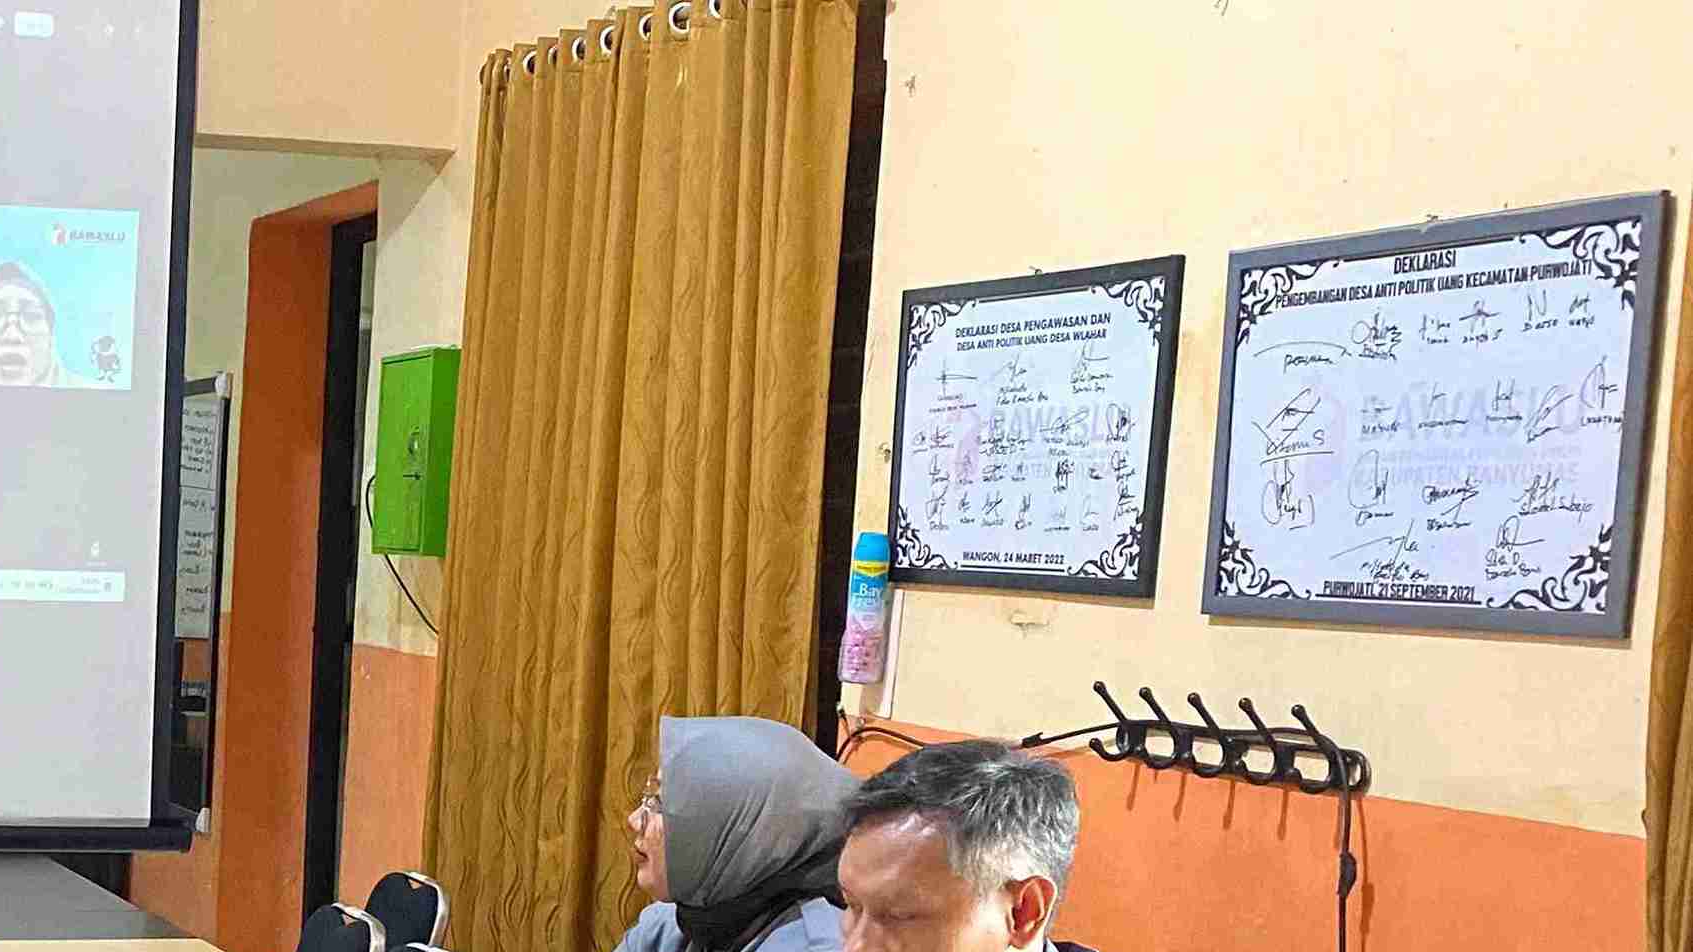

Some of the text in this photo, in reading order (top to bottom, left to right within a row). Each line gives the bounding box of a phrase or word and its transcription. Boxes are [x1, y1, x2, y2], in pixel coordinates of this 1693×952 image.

[1394, 250, 1456, 275] DEKLARASI
[1275, 259, 1592, 309] PENGEMBANGAN DESA ANTI POLITIK UANG KECAMATAN PURWOJATI
[955, 312, 1111, 338] DEKLARASI DESA PENGAWASAN DAN
[957, 341, 975, 351] DESA
[977, 338, 994, 350] ANTI
[996, 336, 1023, 348] POLITIK
[1024, 334, 1048, 345] UANG
[1050, 331, 1070, 343] DESA
[1004, 552, 1014, 562] 24
[1016, 552, 1043, 564] MARET
[1379, 583, 1389, 597] 21
[1390, 583, 1448, 600] SEPTEMBER
[1450, 585, 1475, 601] 2021
